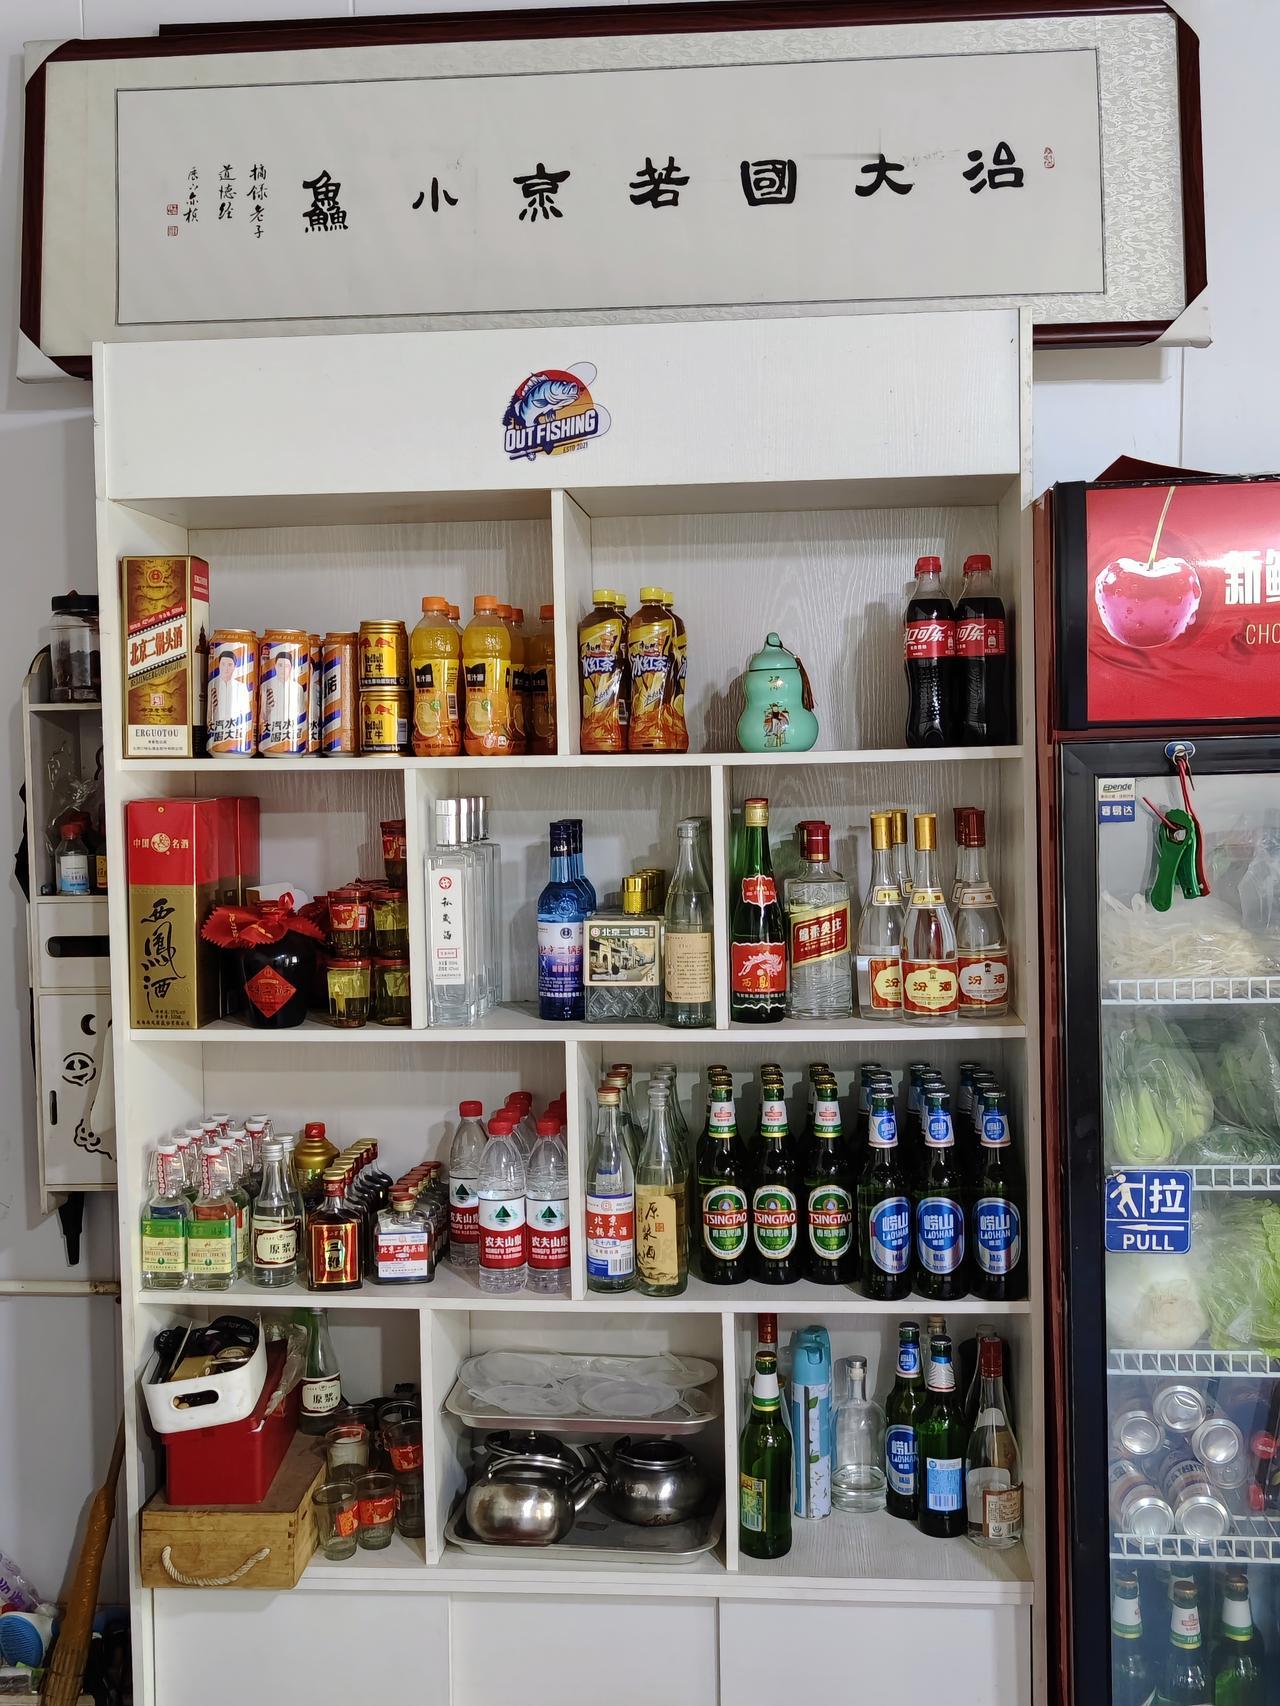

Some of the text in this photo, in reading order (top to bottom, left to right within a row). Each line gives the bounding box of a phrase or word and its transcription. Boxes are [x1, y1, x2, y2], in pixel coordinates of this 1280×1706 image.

[130, 624, 183, 667] 北京二锅头酒
[582, 655, 616, 677] 冰红茶
[136, 729, 179, 738] ERGUOTOU
[601, 926, 649, 937] 北京二锅头
[967, 973, 1006, 986] 汾酒
[912, 980, 953, 993] 汾酒
[1148, 1178, 1186, 1214] 拉
[593, 1215, 618, 1227] 北京
[705, 1212, 747, 1225] TSINGTAO
[754, 1212, 796, 1225] TSINGTAO
[809, 1212, 853, 1225] TSINGTAO
[588, 1226, 628, 1238] 二锅头酒
[882, 1227, 909, 1241] LAOSHAN
[924, 1229, 954, 1240] LAOSHAN
[980, 1229, 1011, 1240] LAOSHAN
[485, 1234, 522, 1248] 农夫山泉
[531, 1236, 568, 1248] 农夫山泉
[1122, 1234, 1175, 1251] PULL
